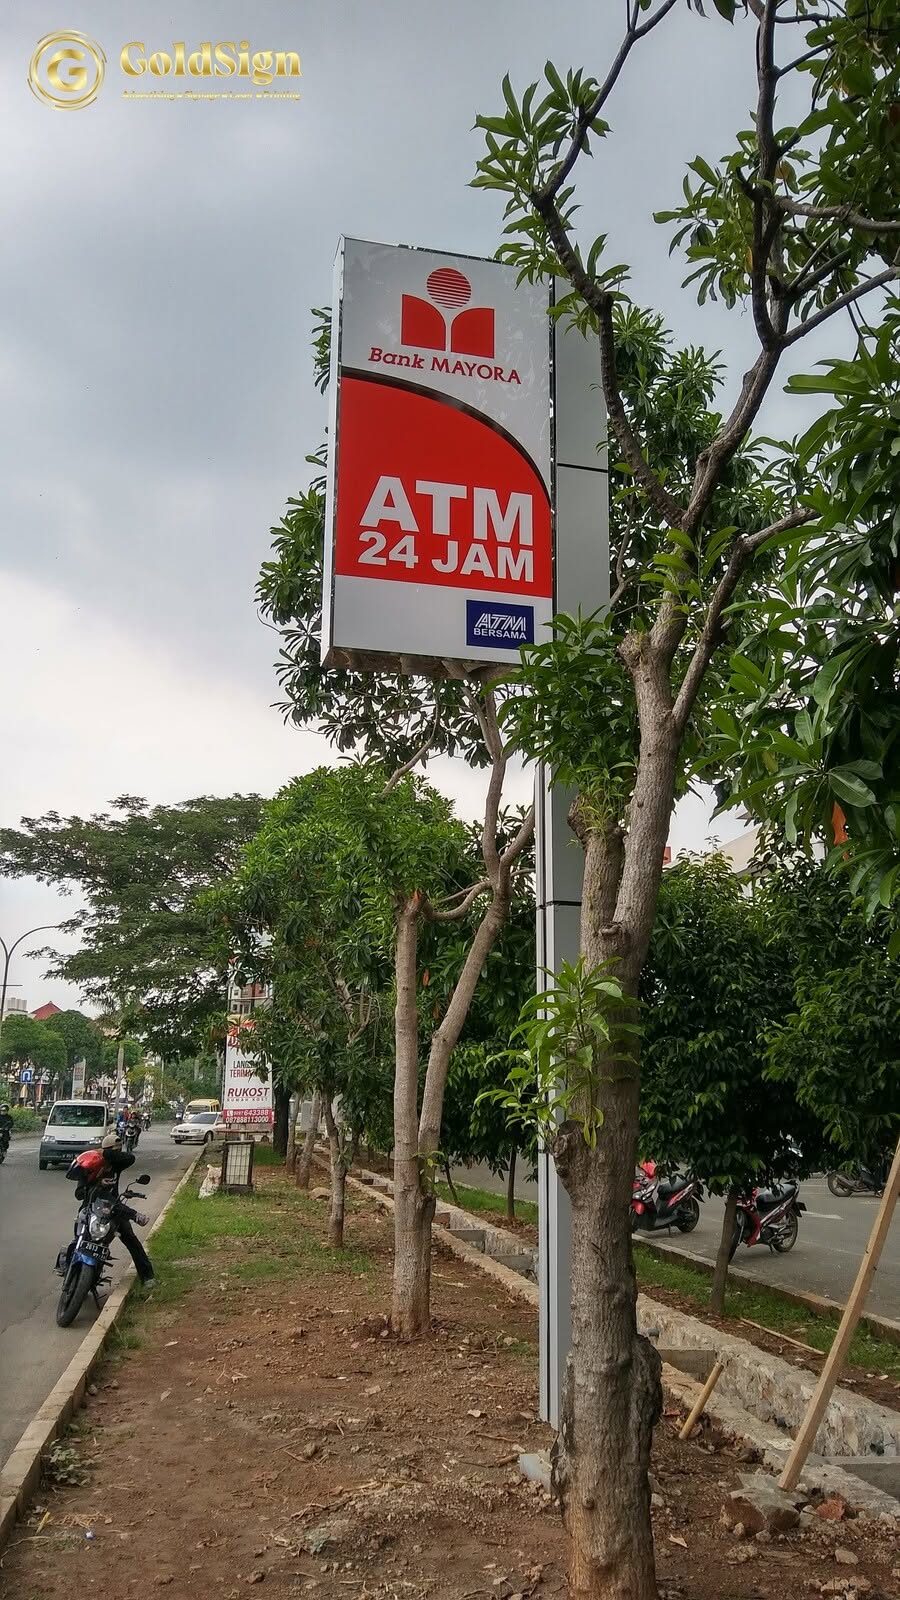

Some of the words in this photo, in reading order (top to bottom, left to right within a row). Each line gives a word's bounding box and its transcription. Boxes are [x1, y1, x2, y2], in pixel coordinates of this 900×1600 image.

[368, 346, 425, 371] Bank
[430, 356, 522, 385] MAYORA
[359, 475, 533, 547] ATM
[358, 530, 419, 569] 24
[431, 539, 534, 583] JAM
[473, 627, 527, 641] BERSAMA
[474, 612, 527, 632] ATM
[227, 1087, 270, 1097] RUKOST
